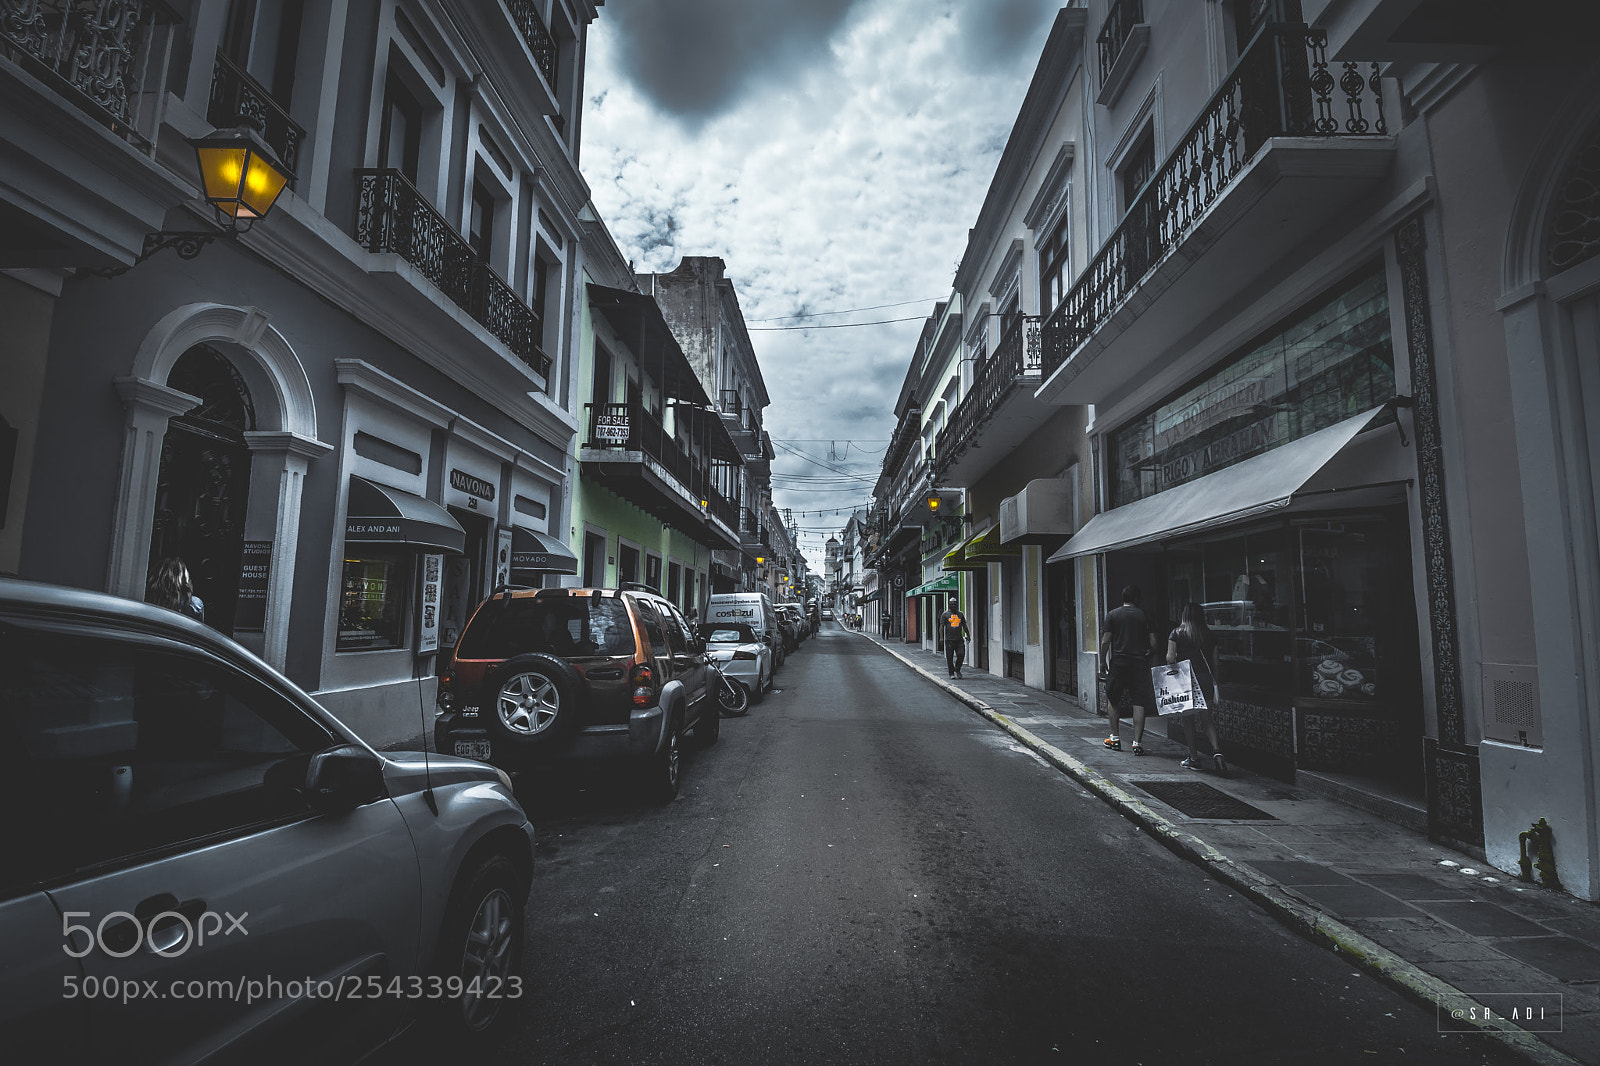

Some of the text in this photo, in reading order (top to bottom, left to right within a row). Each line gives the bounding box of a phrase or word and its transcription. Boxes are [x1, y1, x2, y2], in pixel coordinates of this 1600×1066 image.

[597, 415, 629, 426] FOR SALE
[1162, 454, 1189, 484] RIGO
[1203, 416, 1276, 469] ABRAHAM
[452, 471, 491, 498] NAVONA
[347, 525, 400, 533] ALEX AND ANI
[512, 555, 547, 563] MOVADO
[716, 608, 754, 618] costazul
[1160, 686, 1169, 696] hi.
[1160, 694, 1190, 707] fashion
